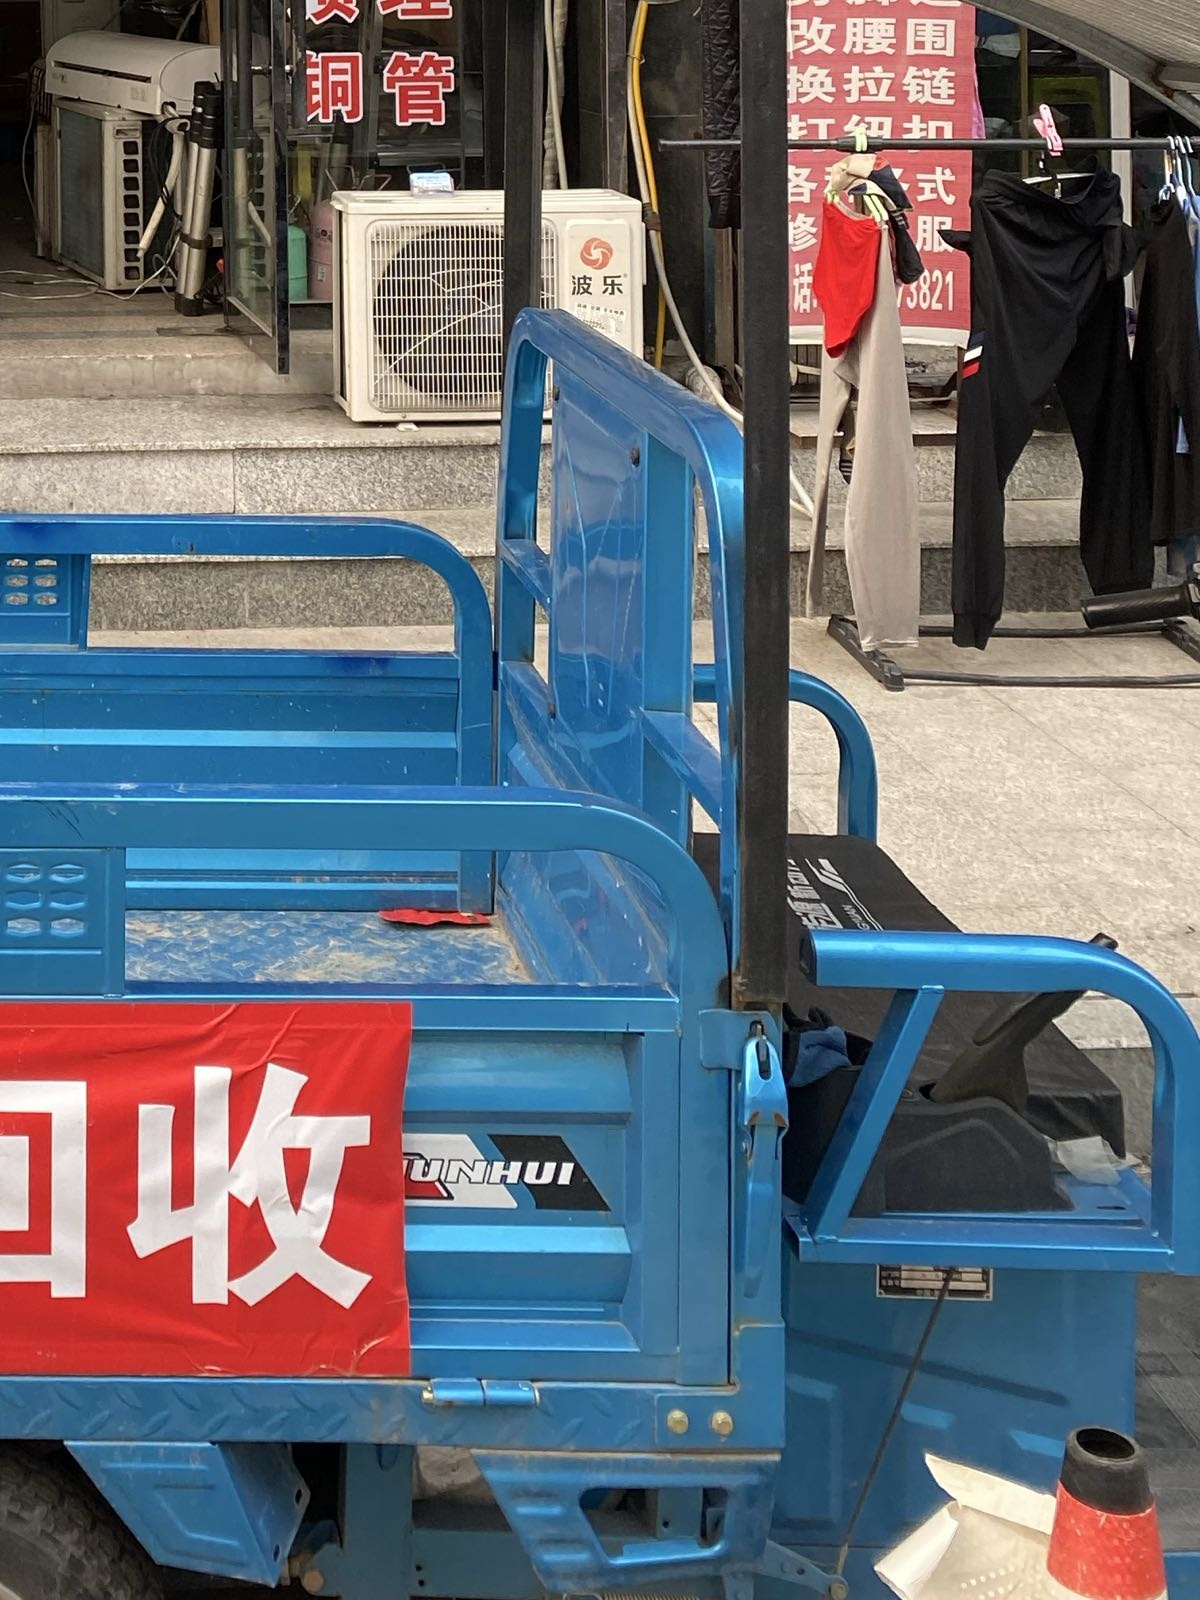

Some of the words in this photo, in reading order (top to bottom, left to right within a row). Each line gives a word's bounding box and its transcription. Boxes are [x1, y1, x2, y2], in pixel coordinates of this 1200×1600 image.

[788, 16, 956, 58] 改腰围
[306, 50, 454, 125] 铜管
[787, 64, 956, 106] 换拉链
[571, 274, 624, 296] 波乐
[403, 1158, 575, 1185] UNHUI
